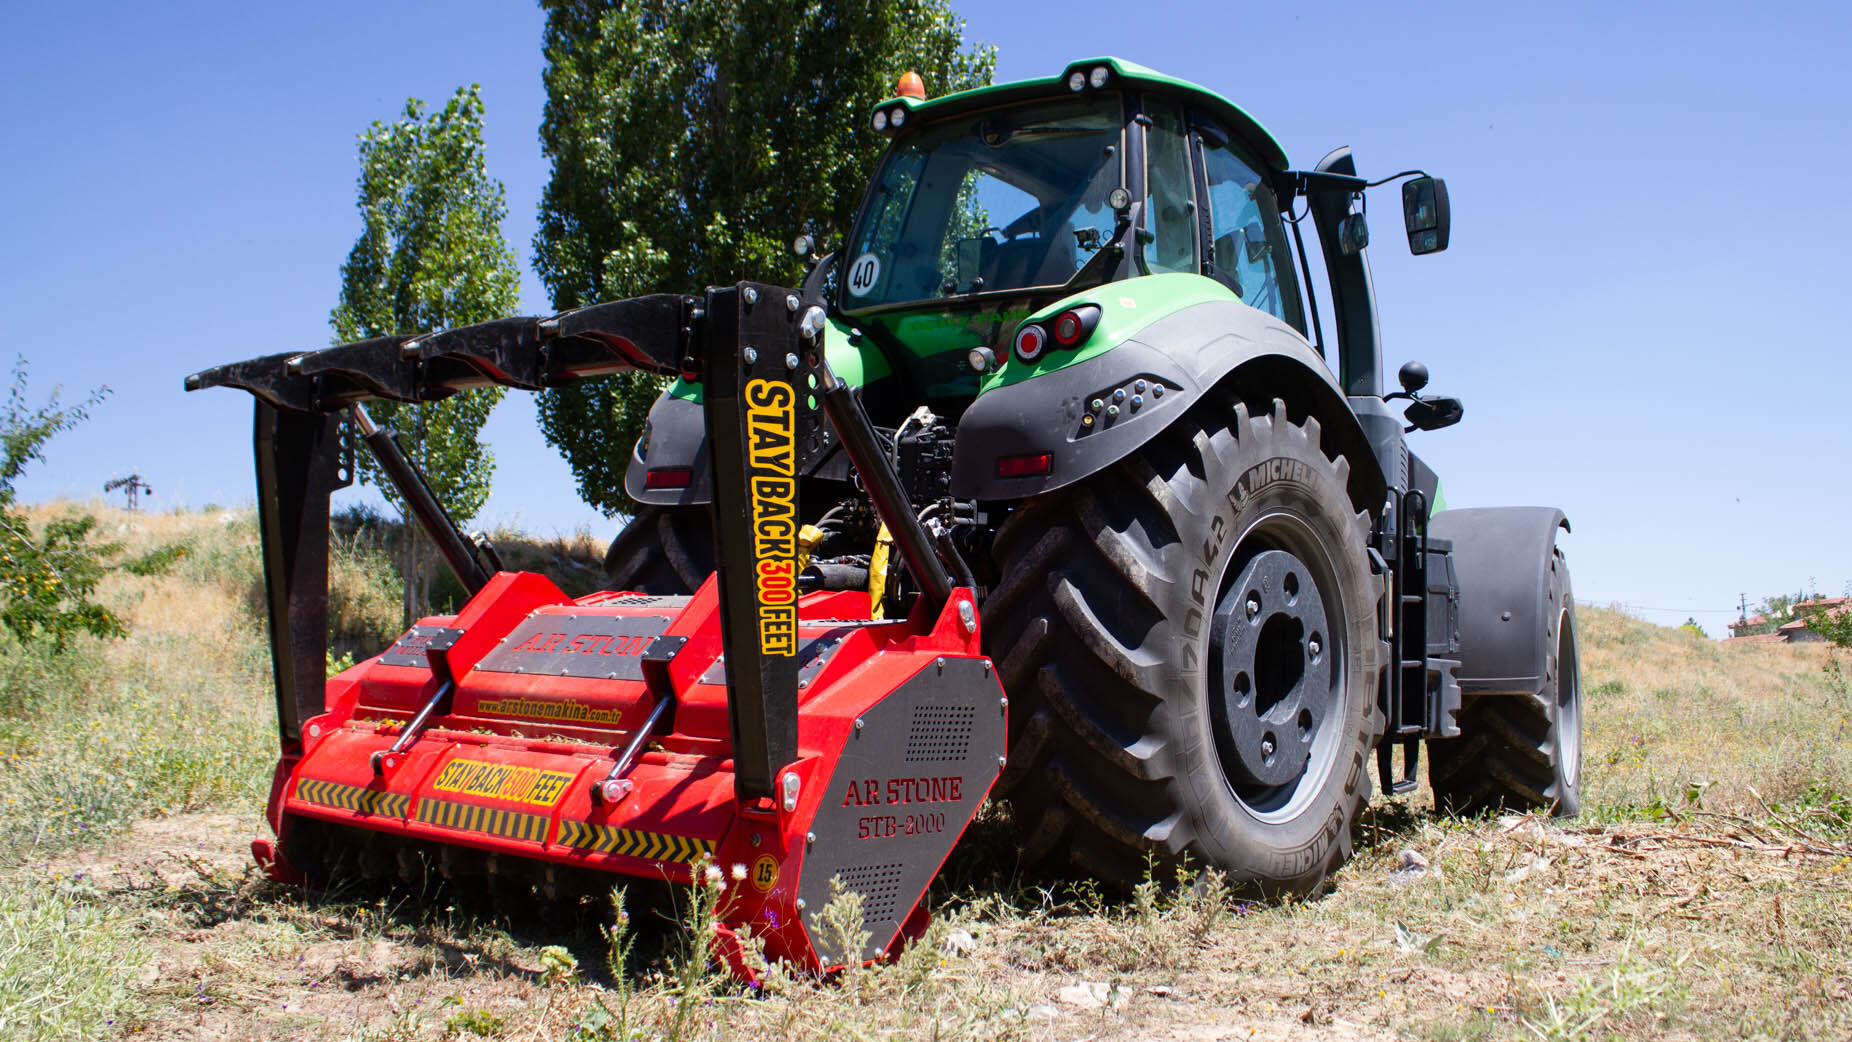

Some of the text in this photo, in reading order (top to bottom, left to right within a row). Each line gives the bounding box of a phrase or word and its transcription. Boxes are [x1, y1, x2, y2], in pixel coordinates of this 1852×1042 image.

[853, 260, 875, 289] 40
[748, 381, 794, 656] STAY BACK 300 FEET
[512, 632, 655, 657] AR STON
[478, 698, 622, 724] www.arstonemakina.com.tr
[435, 760, 573, 804] STAY BACK 300 FEET
[842, 776, 963, 807] AR STONE
[858, 812, 945, 839] STB-2000
[757, 863, 773, 882] 15
